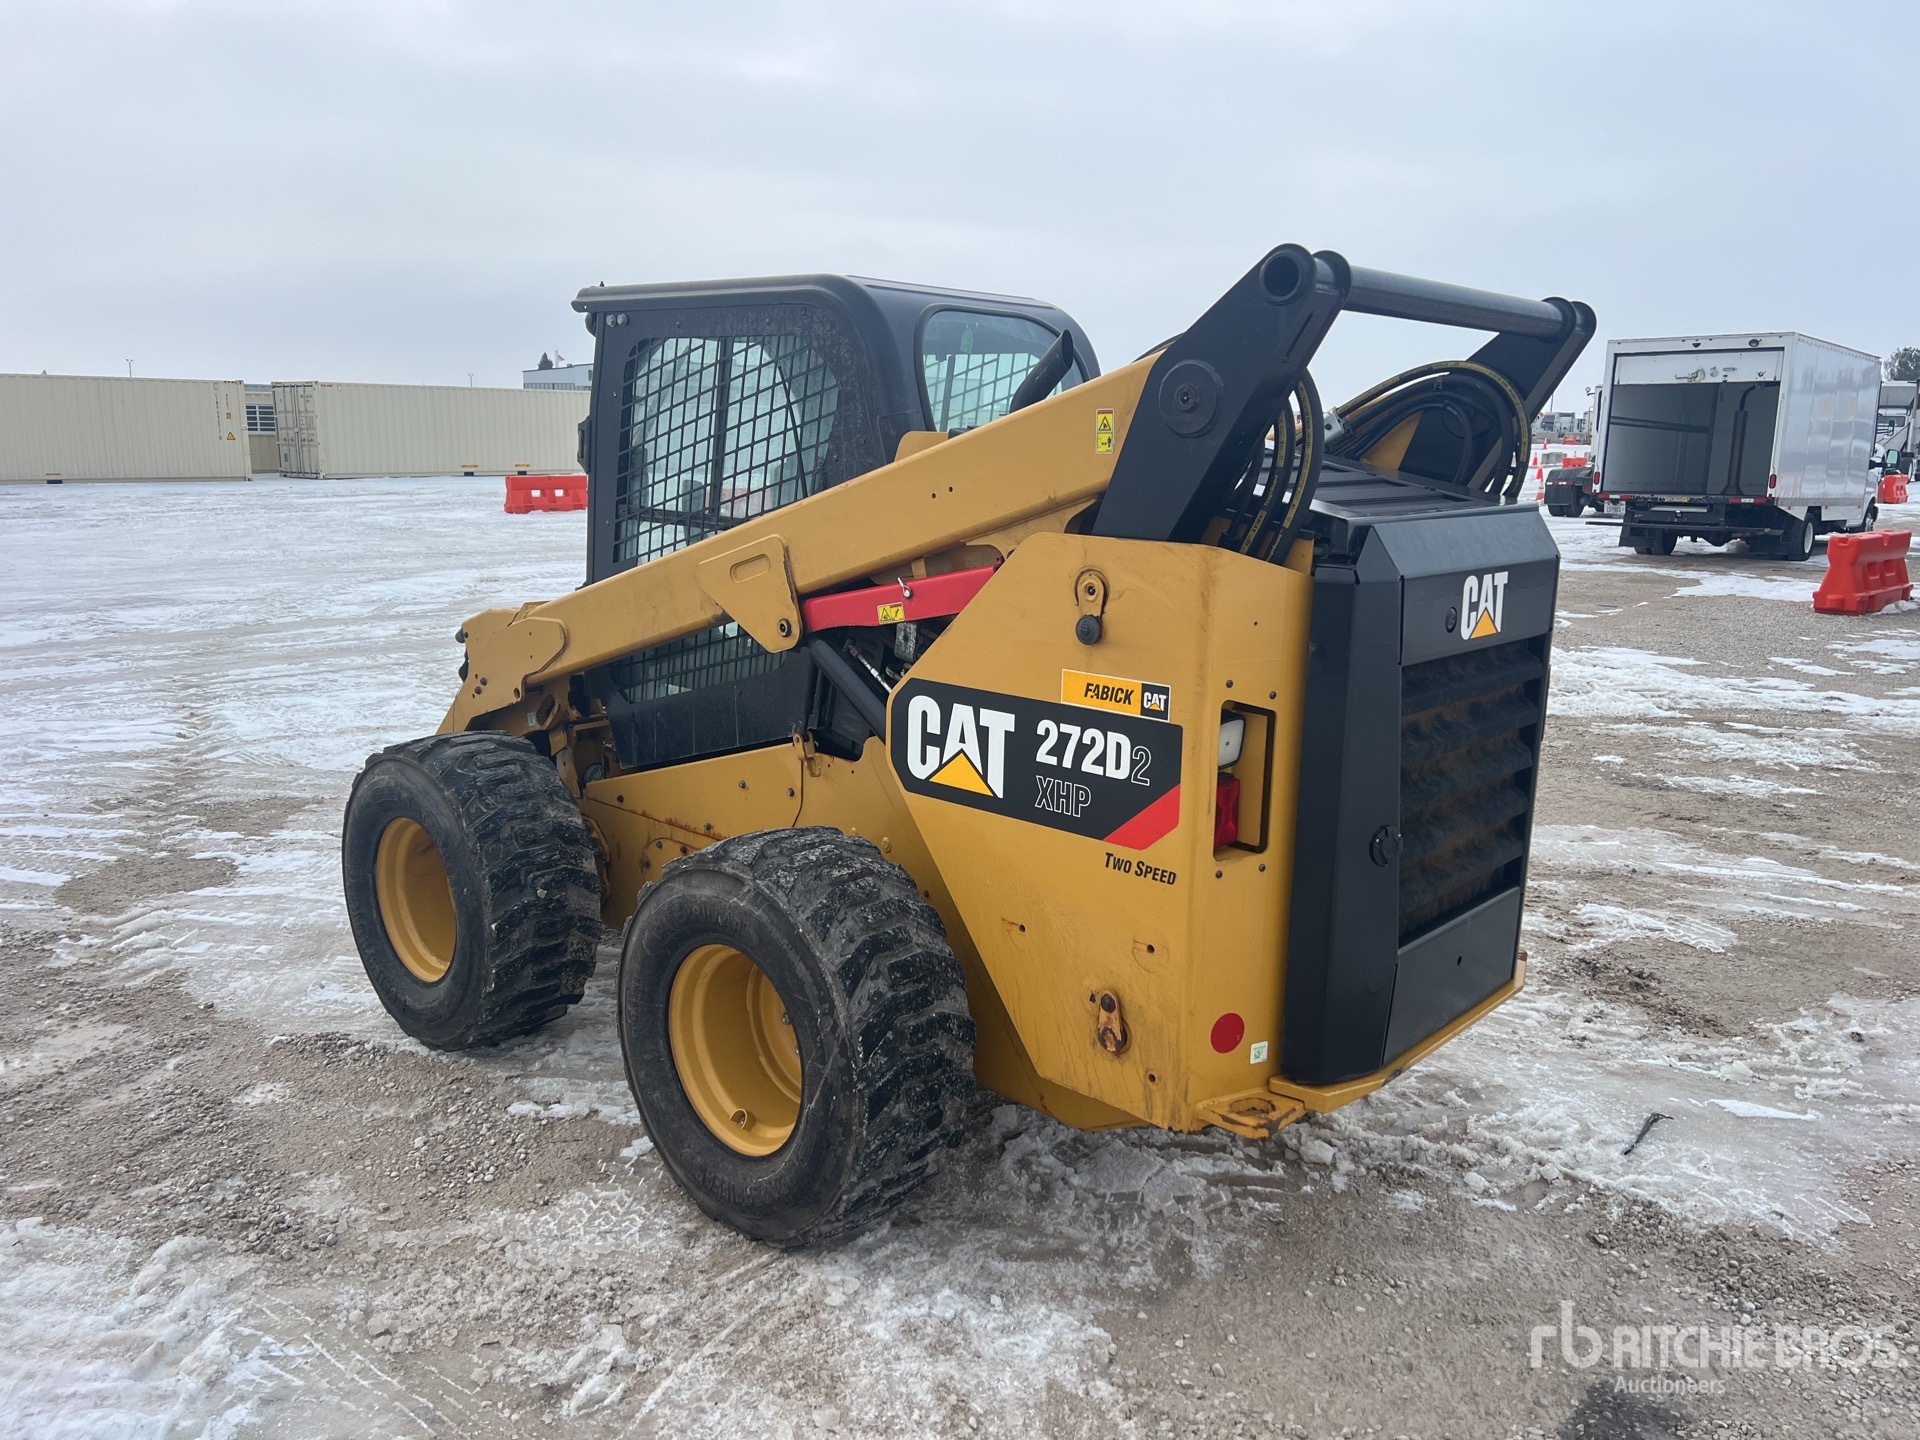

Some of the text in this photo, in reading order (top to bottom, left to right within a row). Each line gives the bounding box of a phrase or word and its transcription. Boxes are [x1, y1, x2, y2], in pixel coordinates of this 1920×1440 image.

[1461, 571, 1509, 640] CAT
[1084, 682, 1167, 711] FABICK CAT
[907, 695, 1015, 799] CAT
[1035, 775, 1092, 818] XHP
